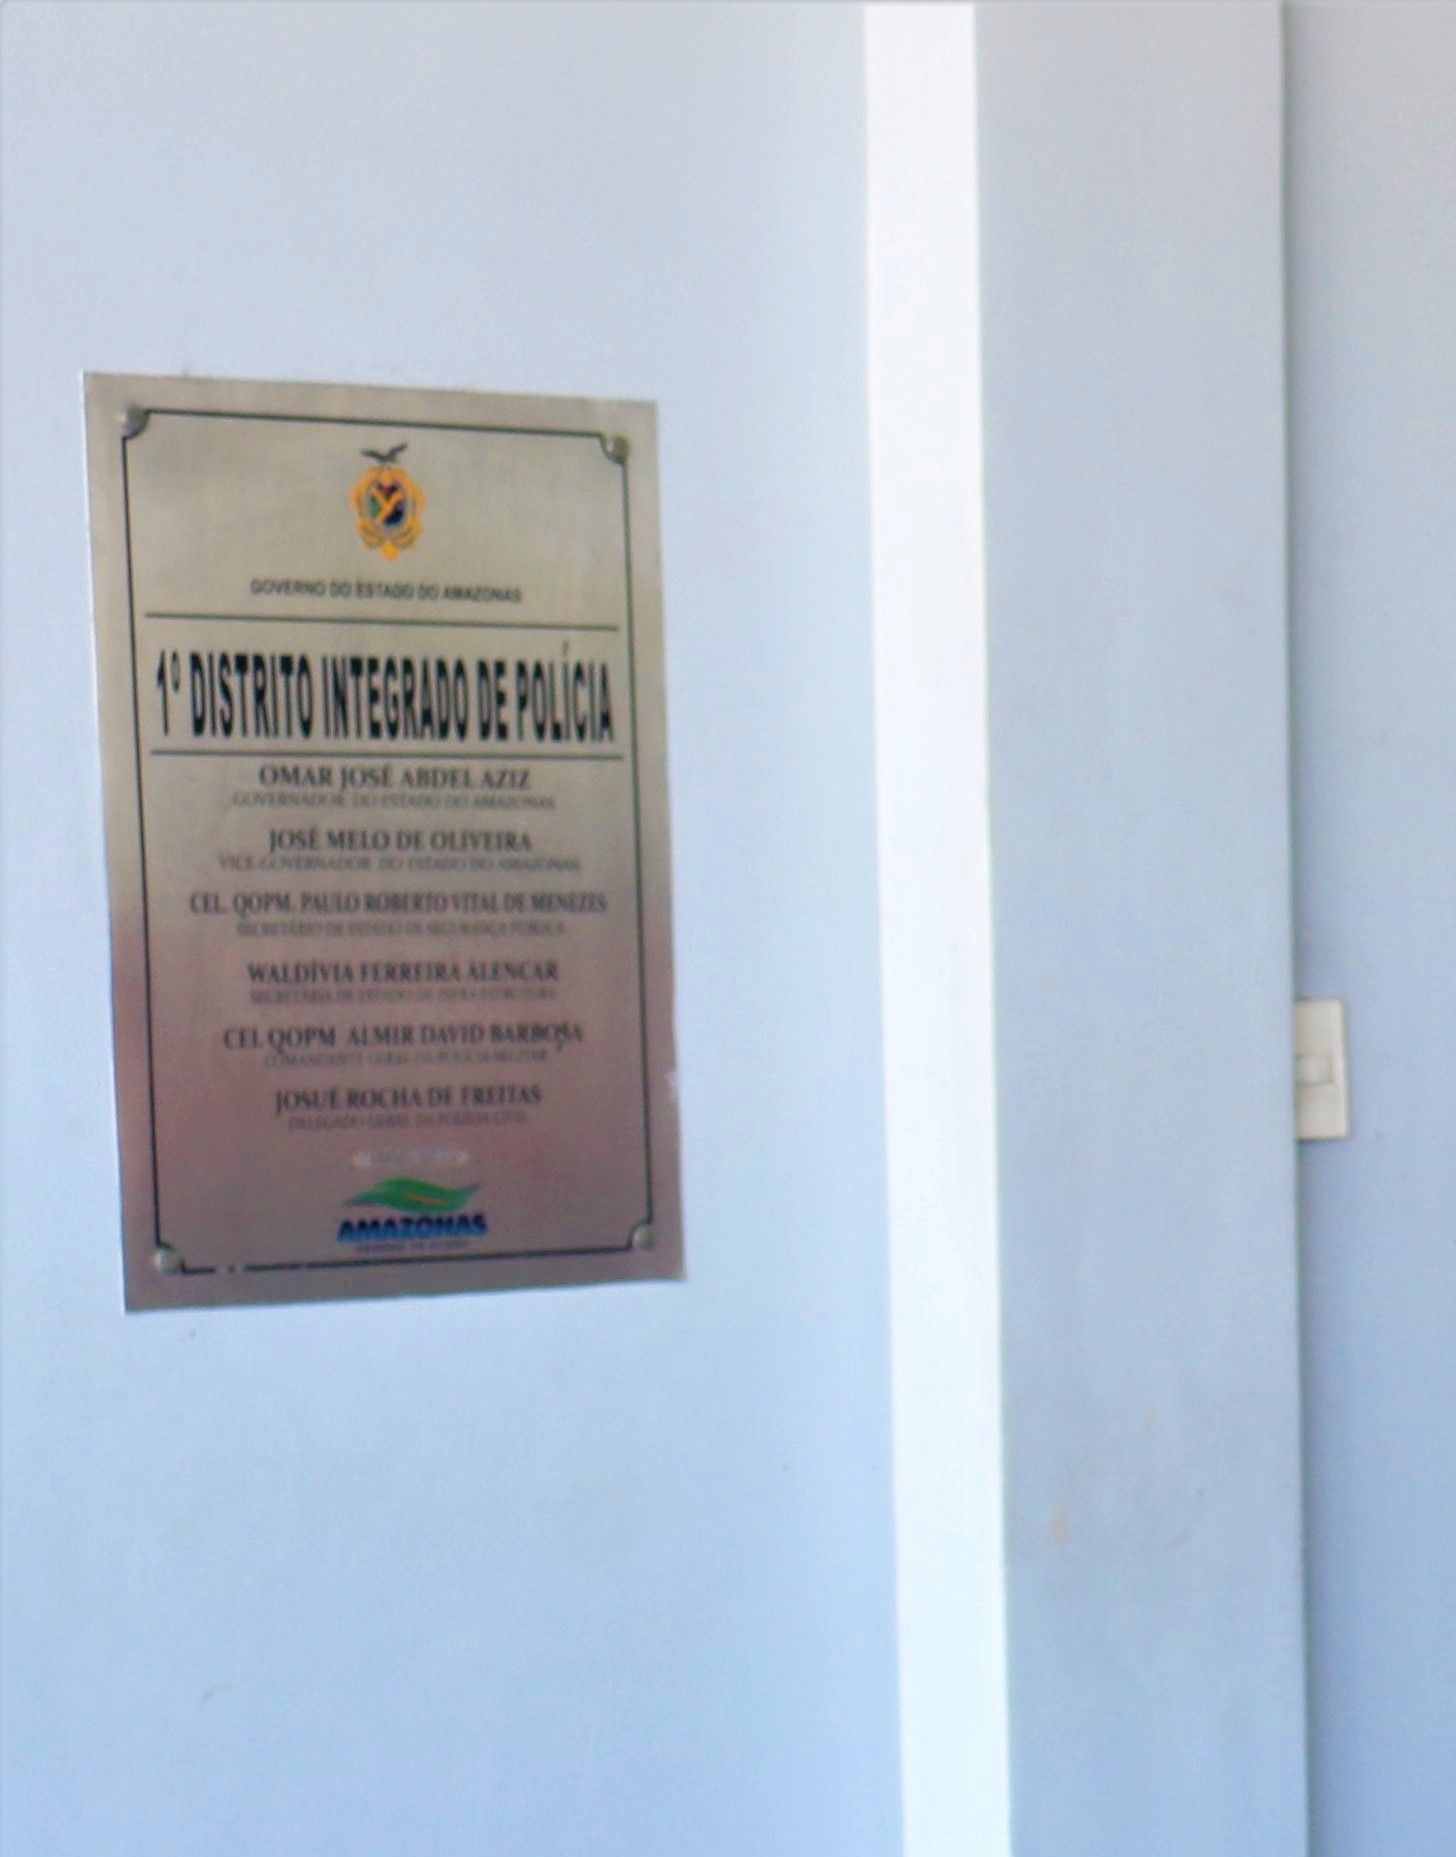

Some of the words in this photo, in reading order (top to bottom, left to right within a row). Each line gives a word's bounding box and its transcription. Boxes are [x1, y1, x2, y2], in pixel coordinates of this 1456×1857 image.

[189, 652, 314, 740] DISTRITO
[321, 653, 469, 741] INTEGRADO
[477, 657, 508, 741] DE
[516, 640, 615, 742] POLÍCIA
[258, 764, 333, 787] OMAR
[339, 763, 391, 789] JOSÉ
[402, 767, 472, 789] ABDEL
[481, 768, 531, 789] AZIZ
[269, 826, 318, 854] JOSÉ
[326, 829, 391, 850] MELO
[396, 830, 421, 850] DE
[430, 831, 533, 850] OLIVEIRA
[336, 1212, 488, 1244] AMAZONAS
